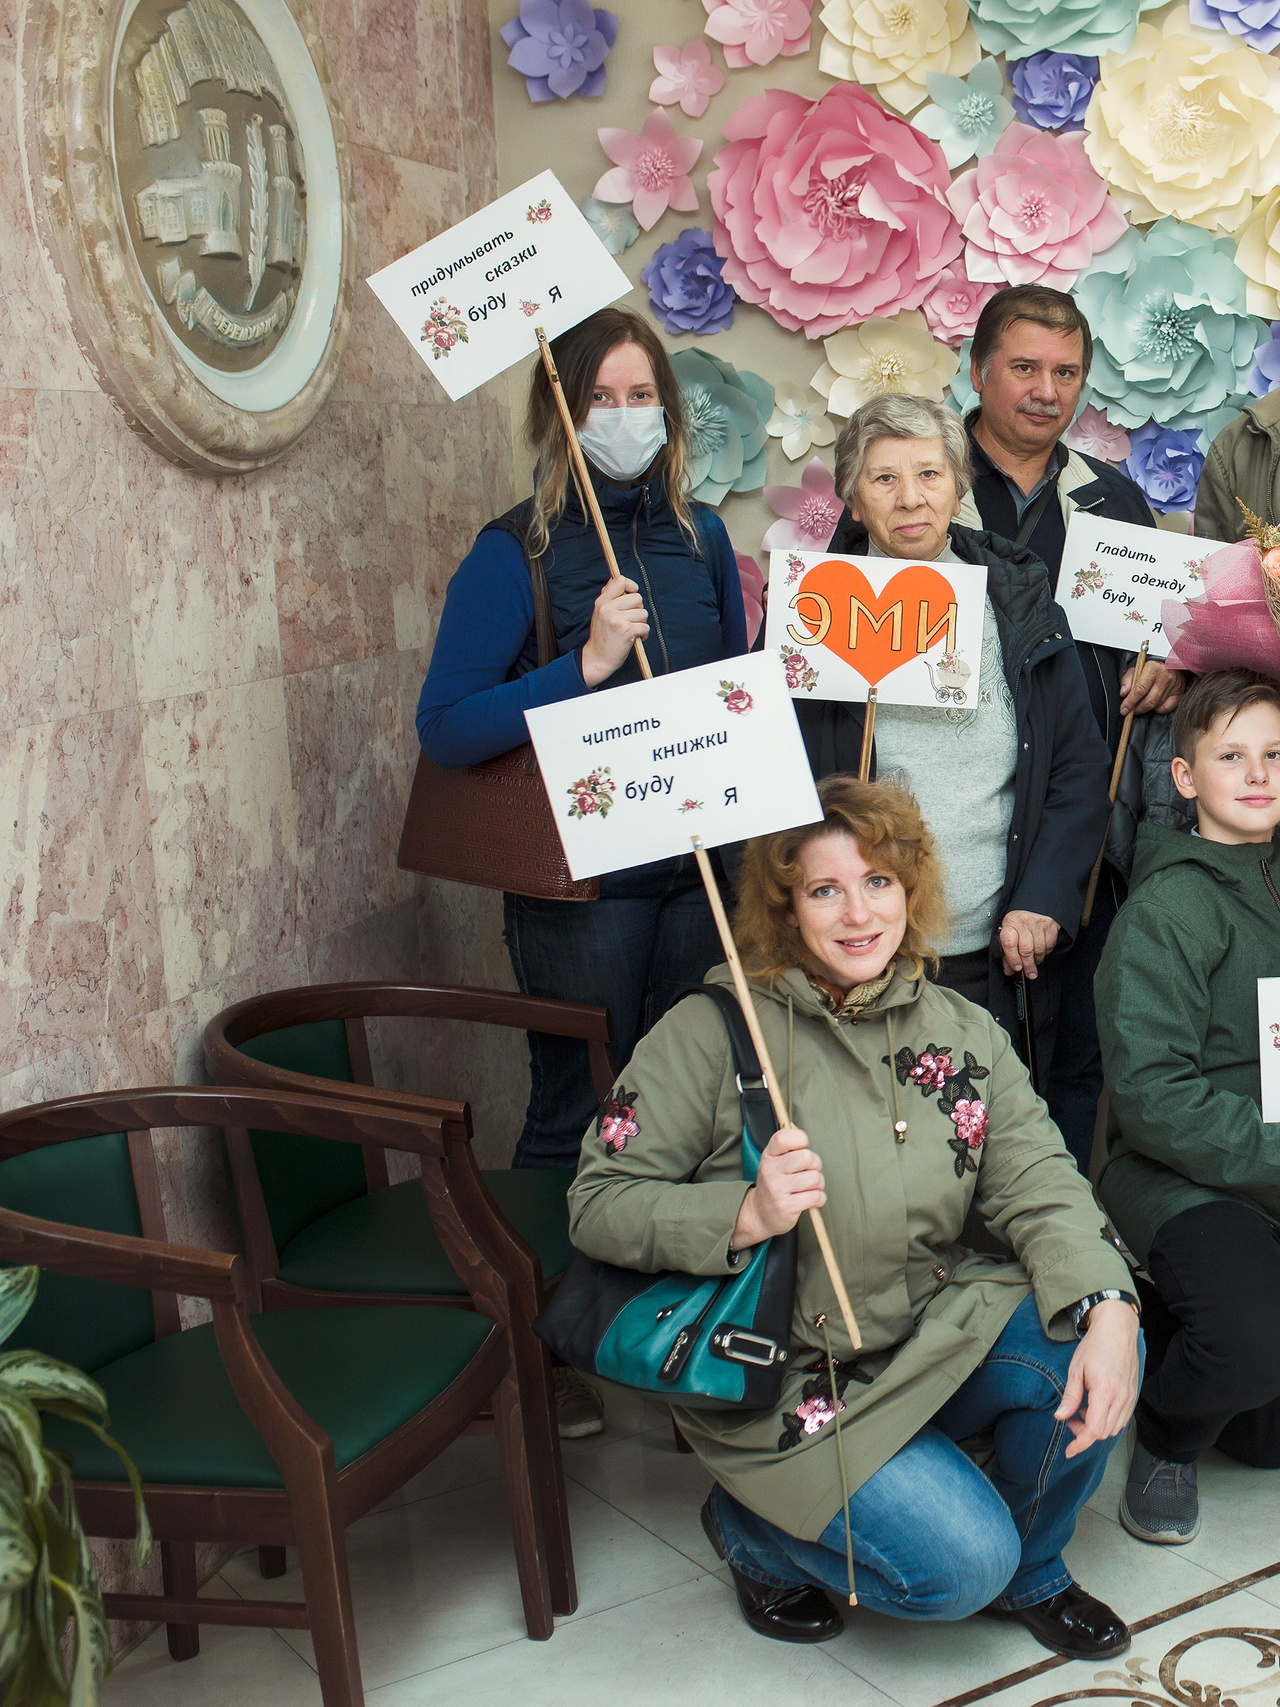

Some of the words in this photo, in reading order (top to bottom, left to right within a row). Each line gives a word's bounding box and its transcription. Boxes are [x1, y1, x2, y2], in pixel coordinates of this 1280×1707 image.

[411, 229, 514, 297] придумывать
[484, 243, 538, 283] сказки
[467, 291, 507, 322] буду
[548, 286, 563, 303] Я
[1095, 541, 1156, 564] Гладить
[1131, 573, 1186, 594] одежду
[1102, 588, 1135, 607] буду
[786, 591, 958, 655] ЭМИ
[1151, 622, 1163, 633] Я
[582, 717, 661, 747] читать
[652, 730, 728, 762] книжки
[624, 775, 675, 802] буду
[724, 787, 738, 806] Я
